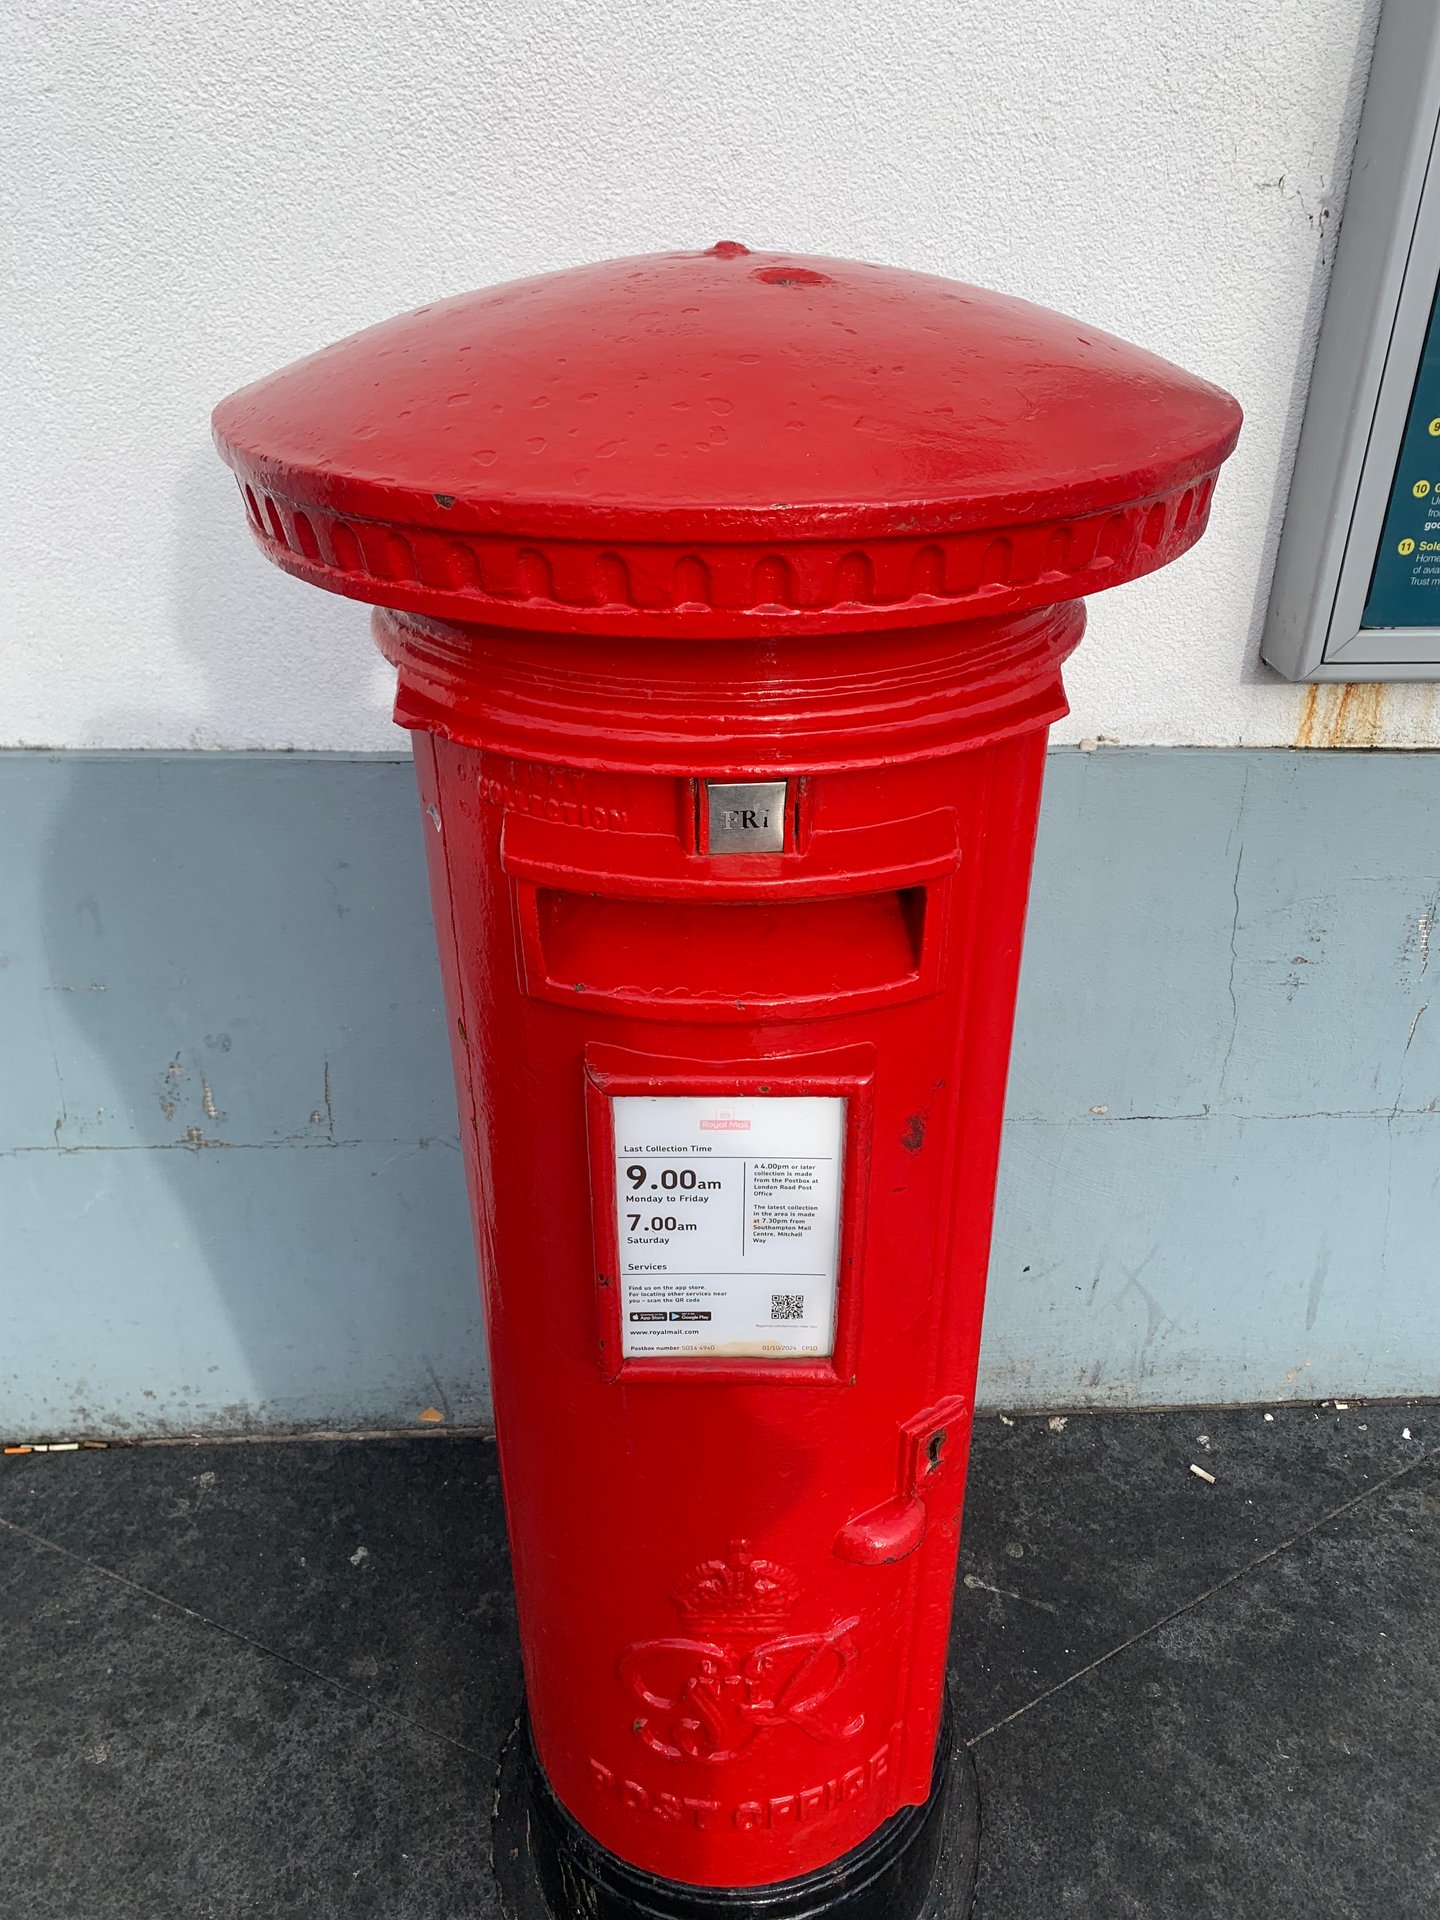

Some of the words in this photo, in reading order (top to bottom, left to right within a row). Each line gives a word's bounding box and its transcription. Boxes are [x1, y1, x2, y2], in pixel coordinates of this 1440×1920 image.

[1416, 484, 1428, 493] 10
[1401, 542, 1411, 551] 11
[1419, 541, 1440, 551] Sole
[1413, 565, 1422, 574] of
[1410, 577, 1430, 586] Trust
[723, 809, 770, 830] FRI
[702, 1121, 727, 1129] Royal
[761, 1163, 789, 1171] 4.00pm
[627, 1165, 721, 1190] 9.00am
[680, 1195, 708, 1203] Friday
[627, 1214, 697, 1231] 7.00am
[627, 1237, 669, 1245] Saturday
[588, 1757, 720, 1830] POST
[732, 1743, 890, 1830] OFFICE
